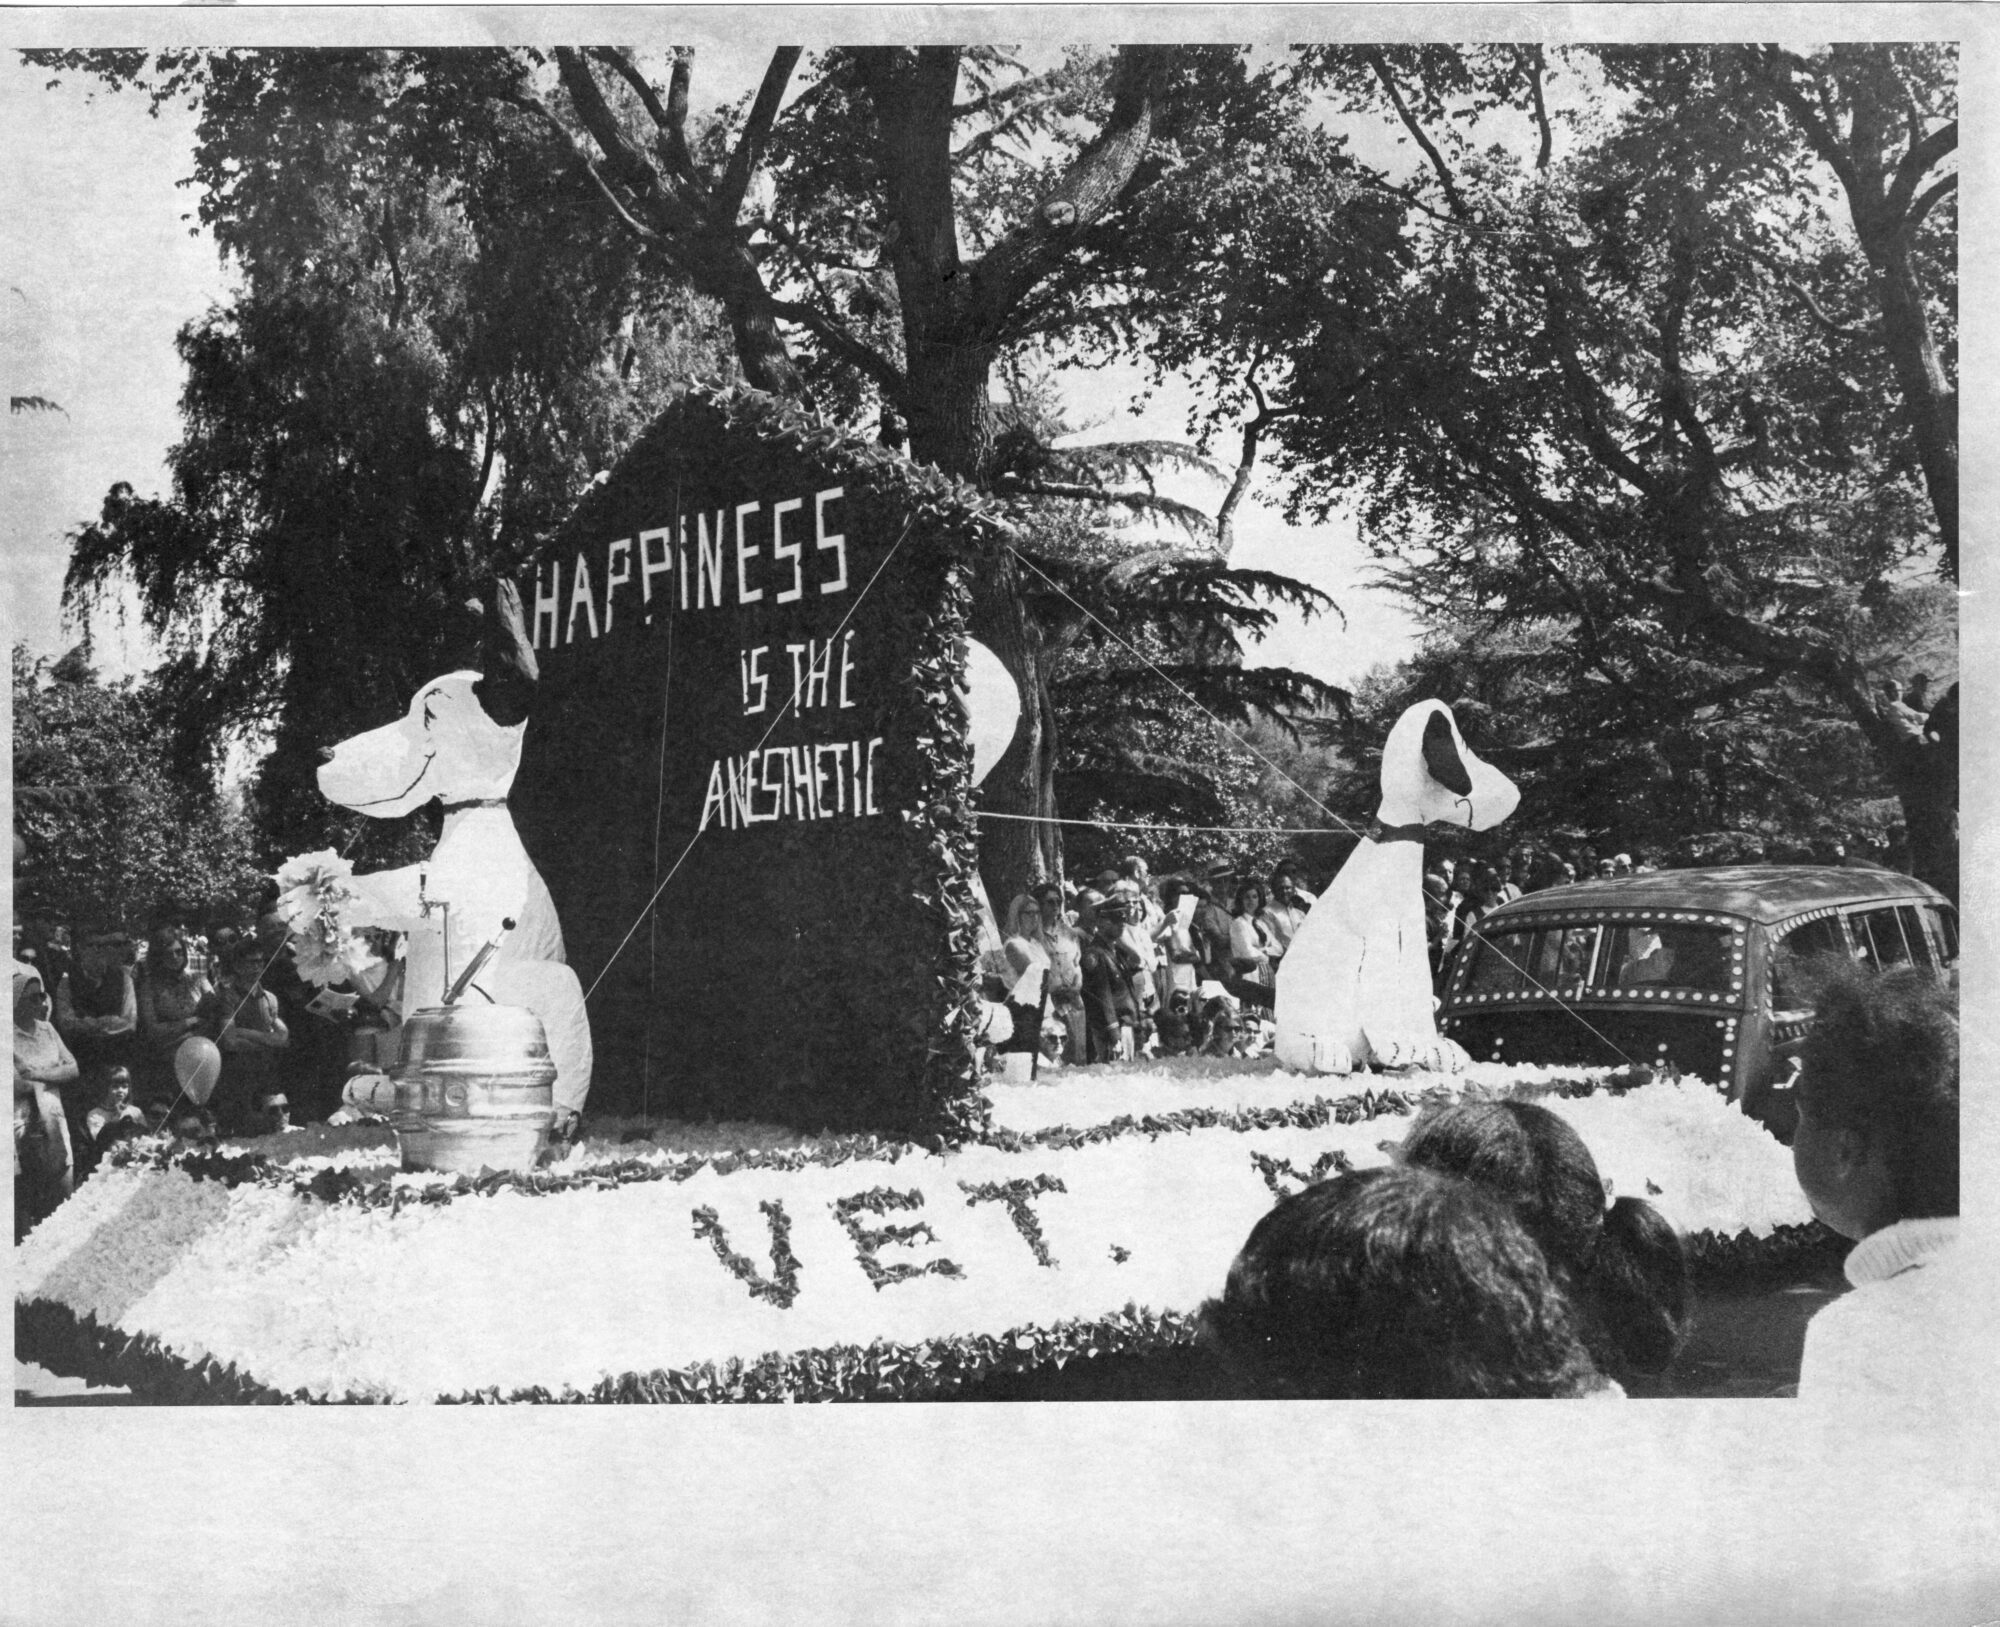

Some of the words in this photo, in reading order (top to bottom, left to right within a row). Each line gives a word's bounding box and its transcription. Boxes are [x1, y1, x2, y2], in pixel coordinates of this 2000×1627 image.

[786, 629, 856, 718] THE
[699, 737, 884, 831] ANESTHETIC
[691, 1172, 1132, 1309] VET.
